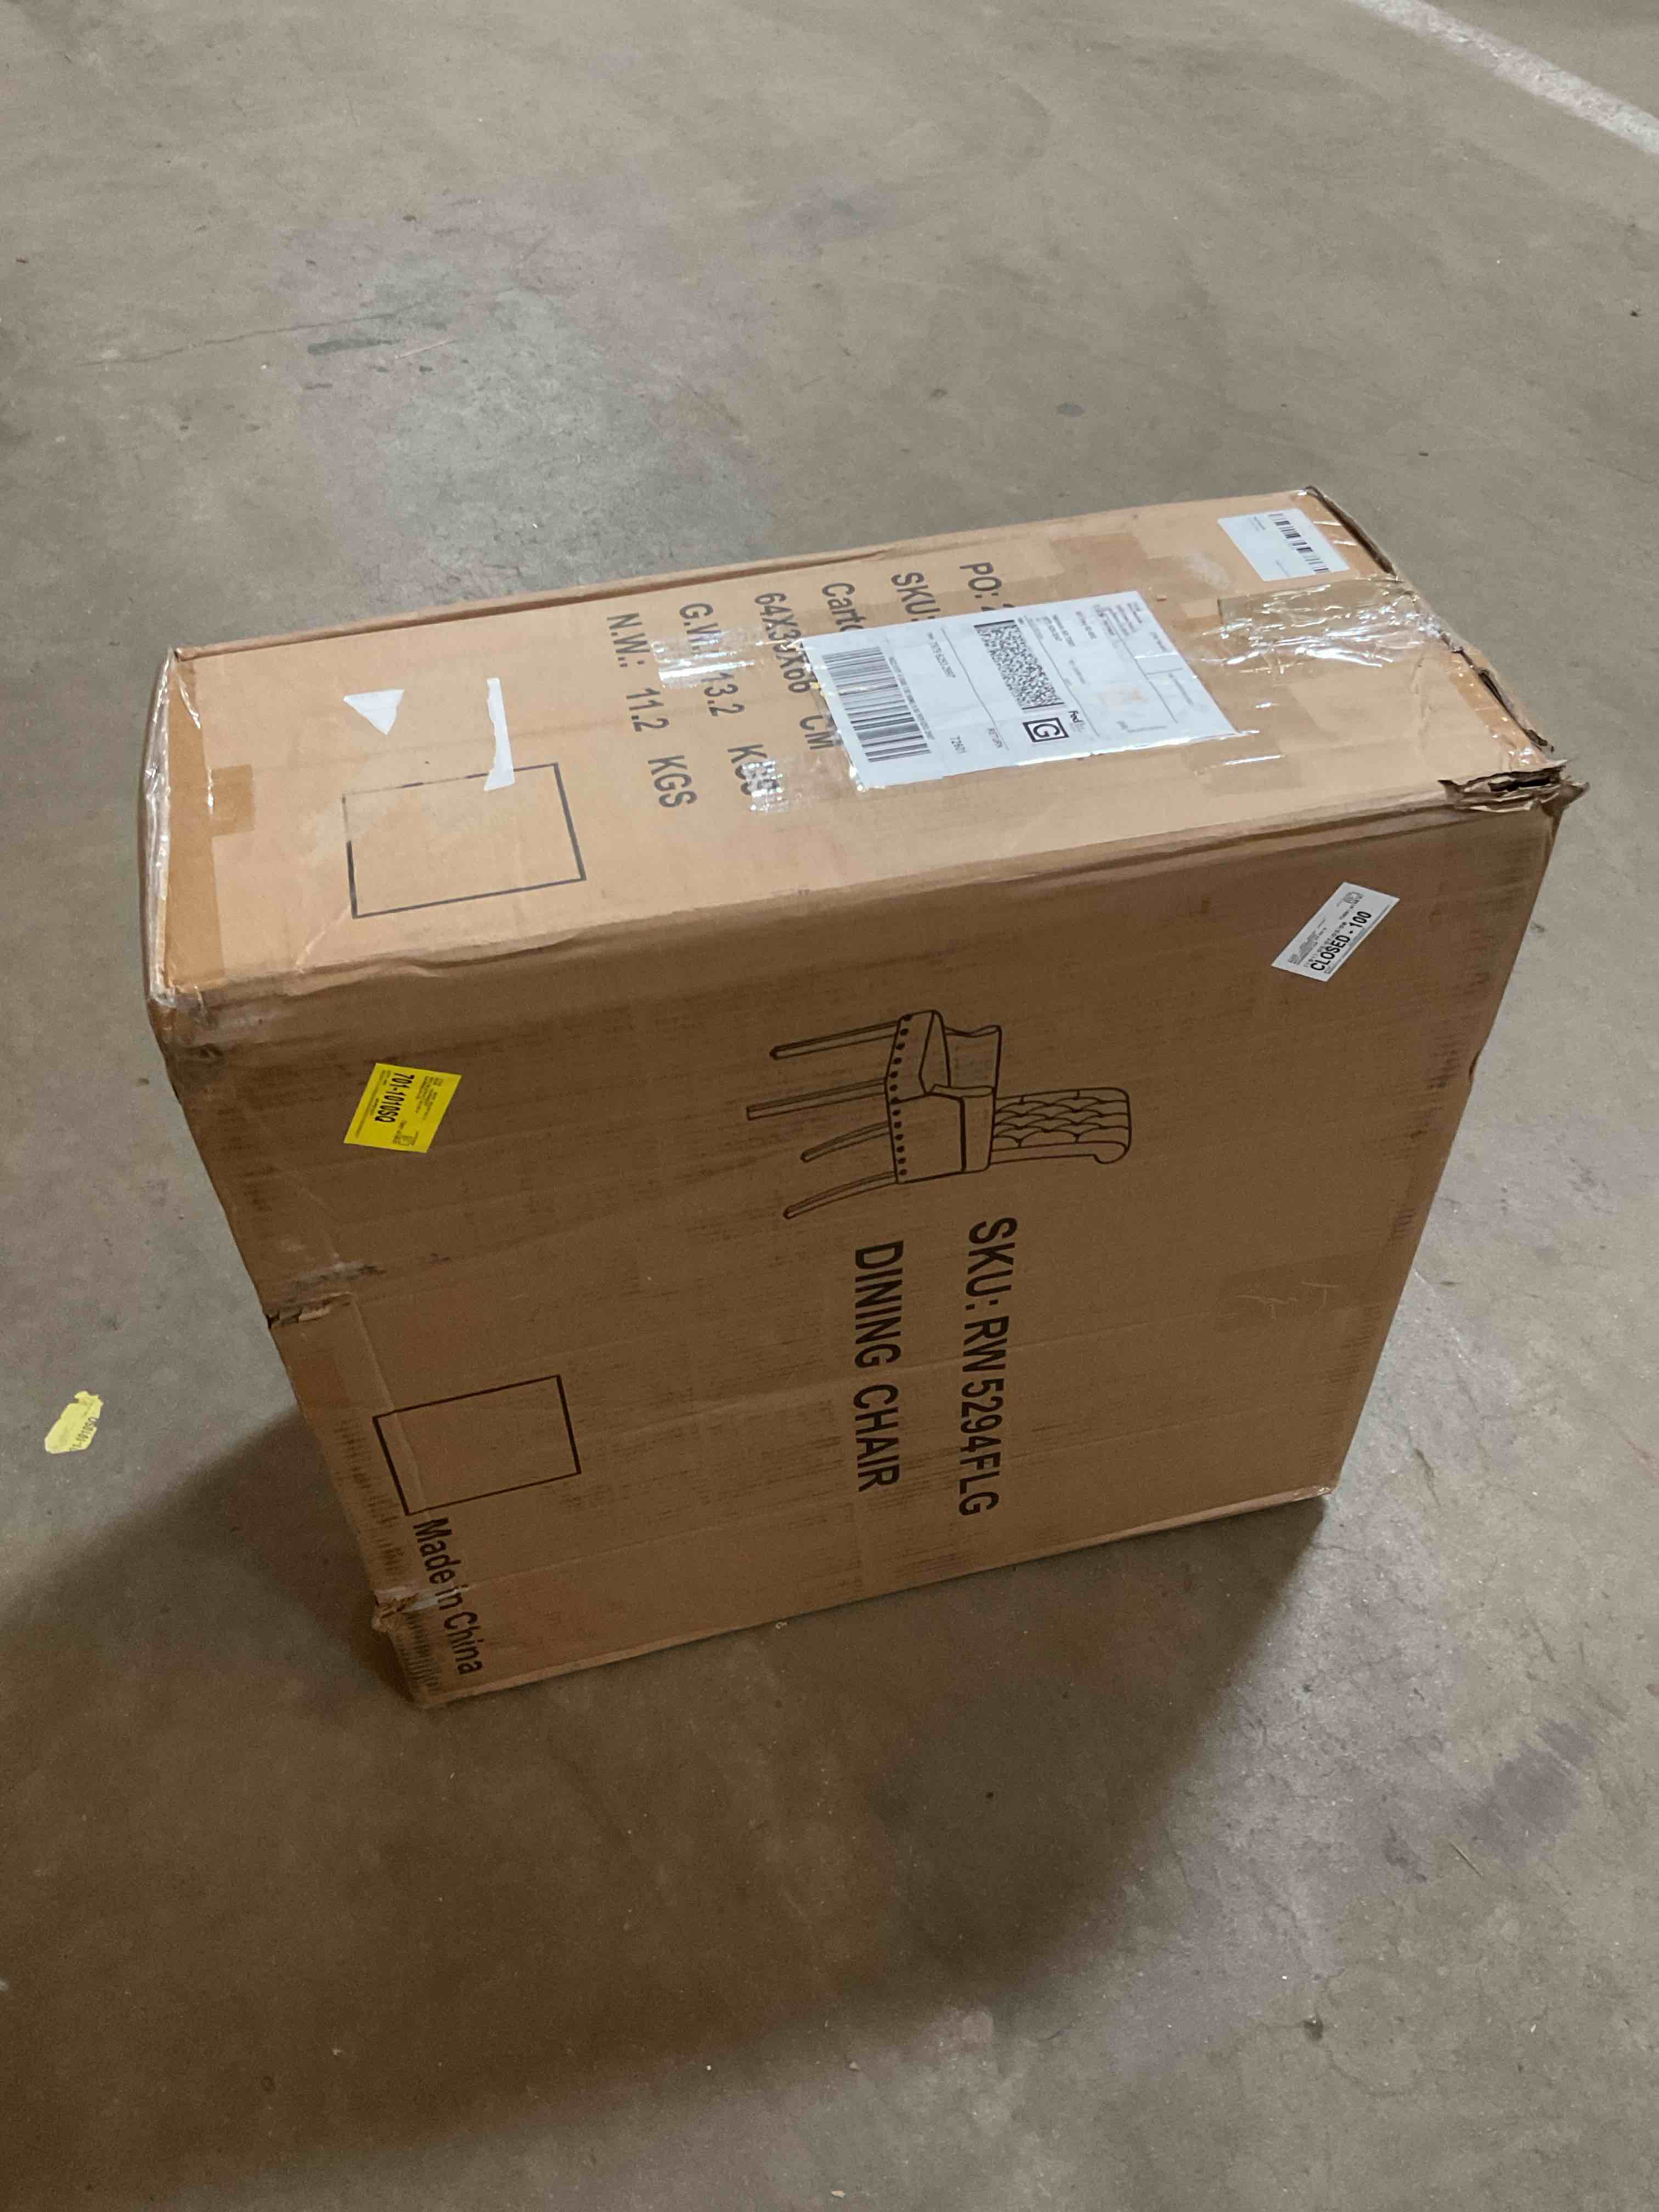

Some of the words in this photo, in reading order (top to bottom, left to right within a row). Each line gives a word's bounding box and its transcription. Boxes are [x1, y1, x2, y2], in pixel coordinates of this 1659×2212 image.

[891, 572, 940, 622] SKU:
[960, 562, 1002, 599] PO:
[606, 612, 651, 667] N.W.:
[626, 688, 669, 732] 11.2
[701, 672, 745, 716] 13.2
[799, 715, 837, 749] CM
[1032, 723, 1061, 738] G
[648, 755, 697, 808] KGS
[1310, 934, 1351, 971] CLOSED
[1348, 911, 1372, 928] 100
[375, 1073, 415, 1122] 701-1010SQ
[965, 1217, 1018, 1311] SKU:
[854, 1240, 904, 1368] DINING
[853, 1384, 900, 1492] CHAIR
[413, 1517, 461, 1584] Made
[435, 1584, 469, 1611] in
[443, 1611, 485, 1674] China
